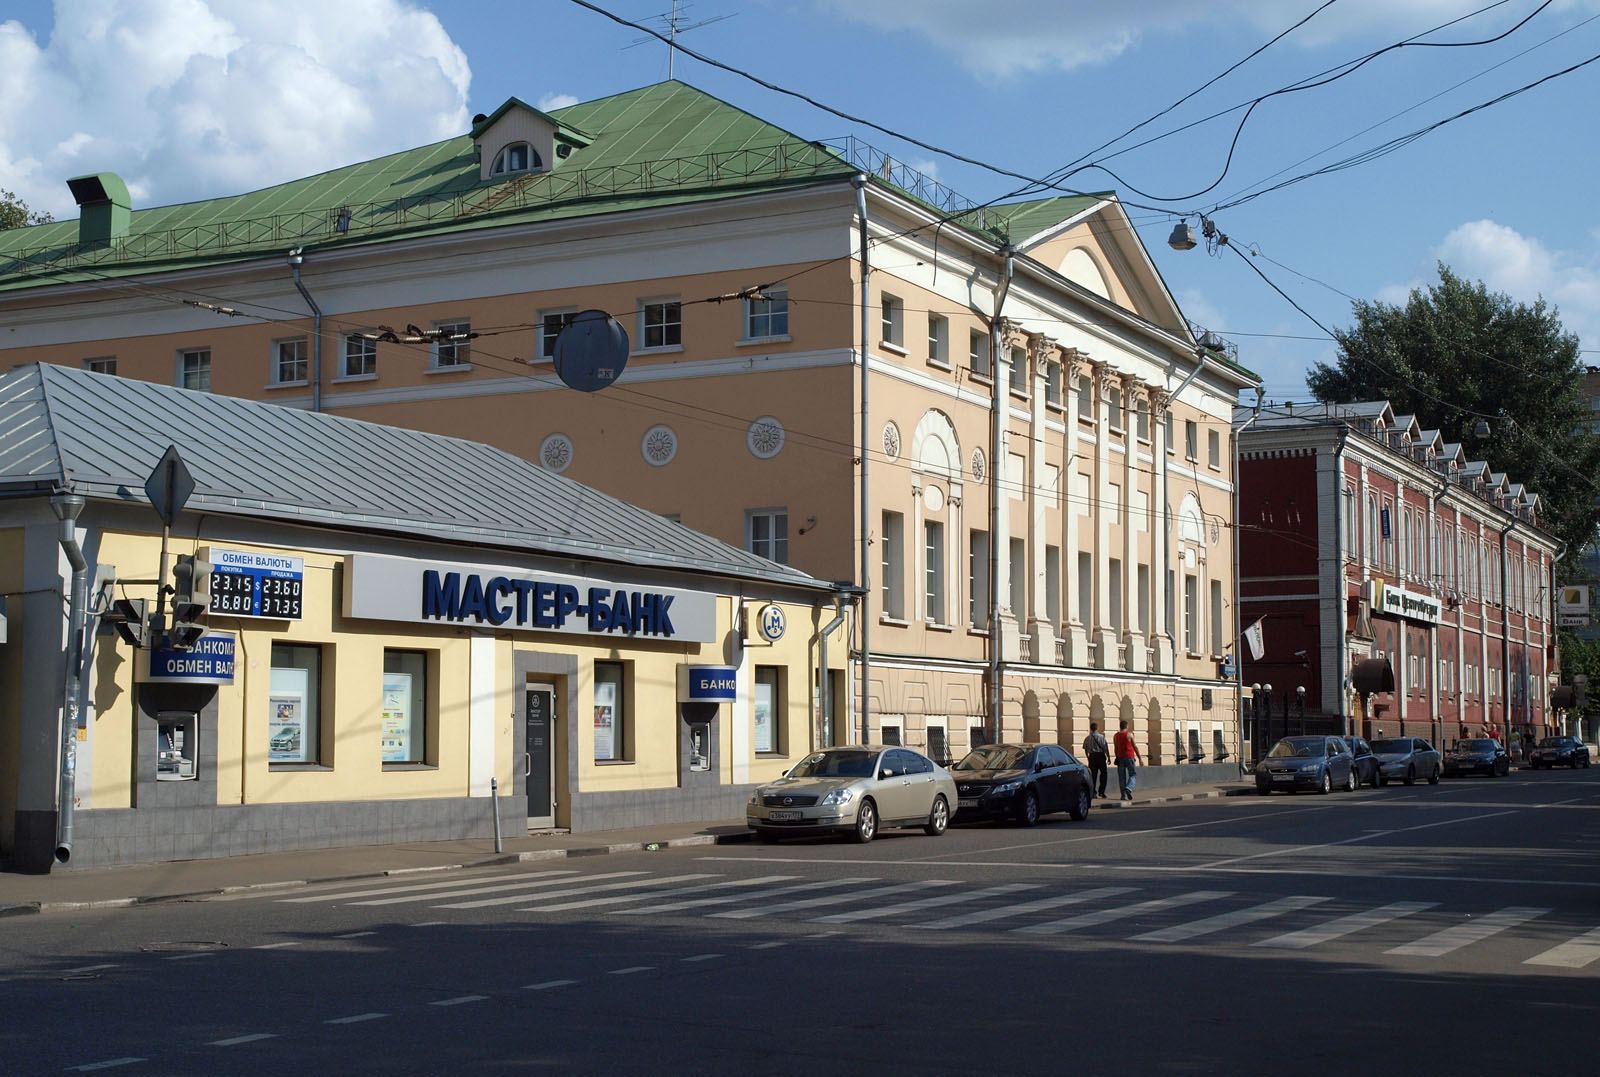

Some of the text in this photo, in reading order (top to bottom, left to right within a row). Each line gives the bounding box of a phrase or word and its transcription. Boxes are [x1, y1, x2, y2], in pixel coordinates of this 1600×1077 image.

[223, 553, 292, 569] ОБМЕН ВАЛЮТЫ
[271, 570, 294, 578] ПРОДАЖА
[212, 574, 300, 596] 23.15 $ 23.60
[212, 593, 252, 611] 36.80
[263, 598, 299, 615] 37.35
[422, 569, 676, 638] МАСТЕР-БАНК
[167, 659, 212, 674] ОБМЕН
